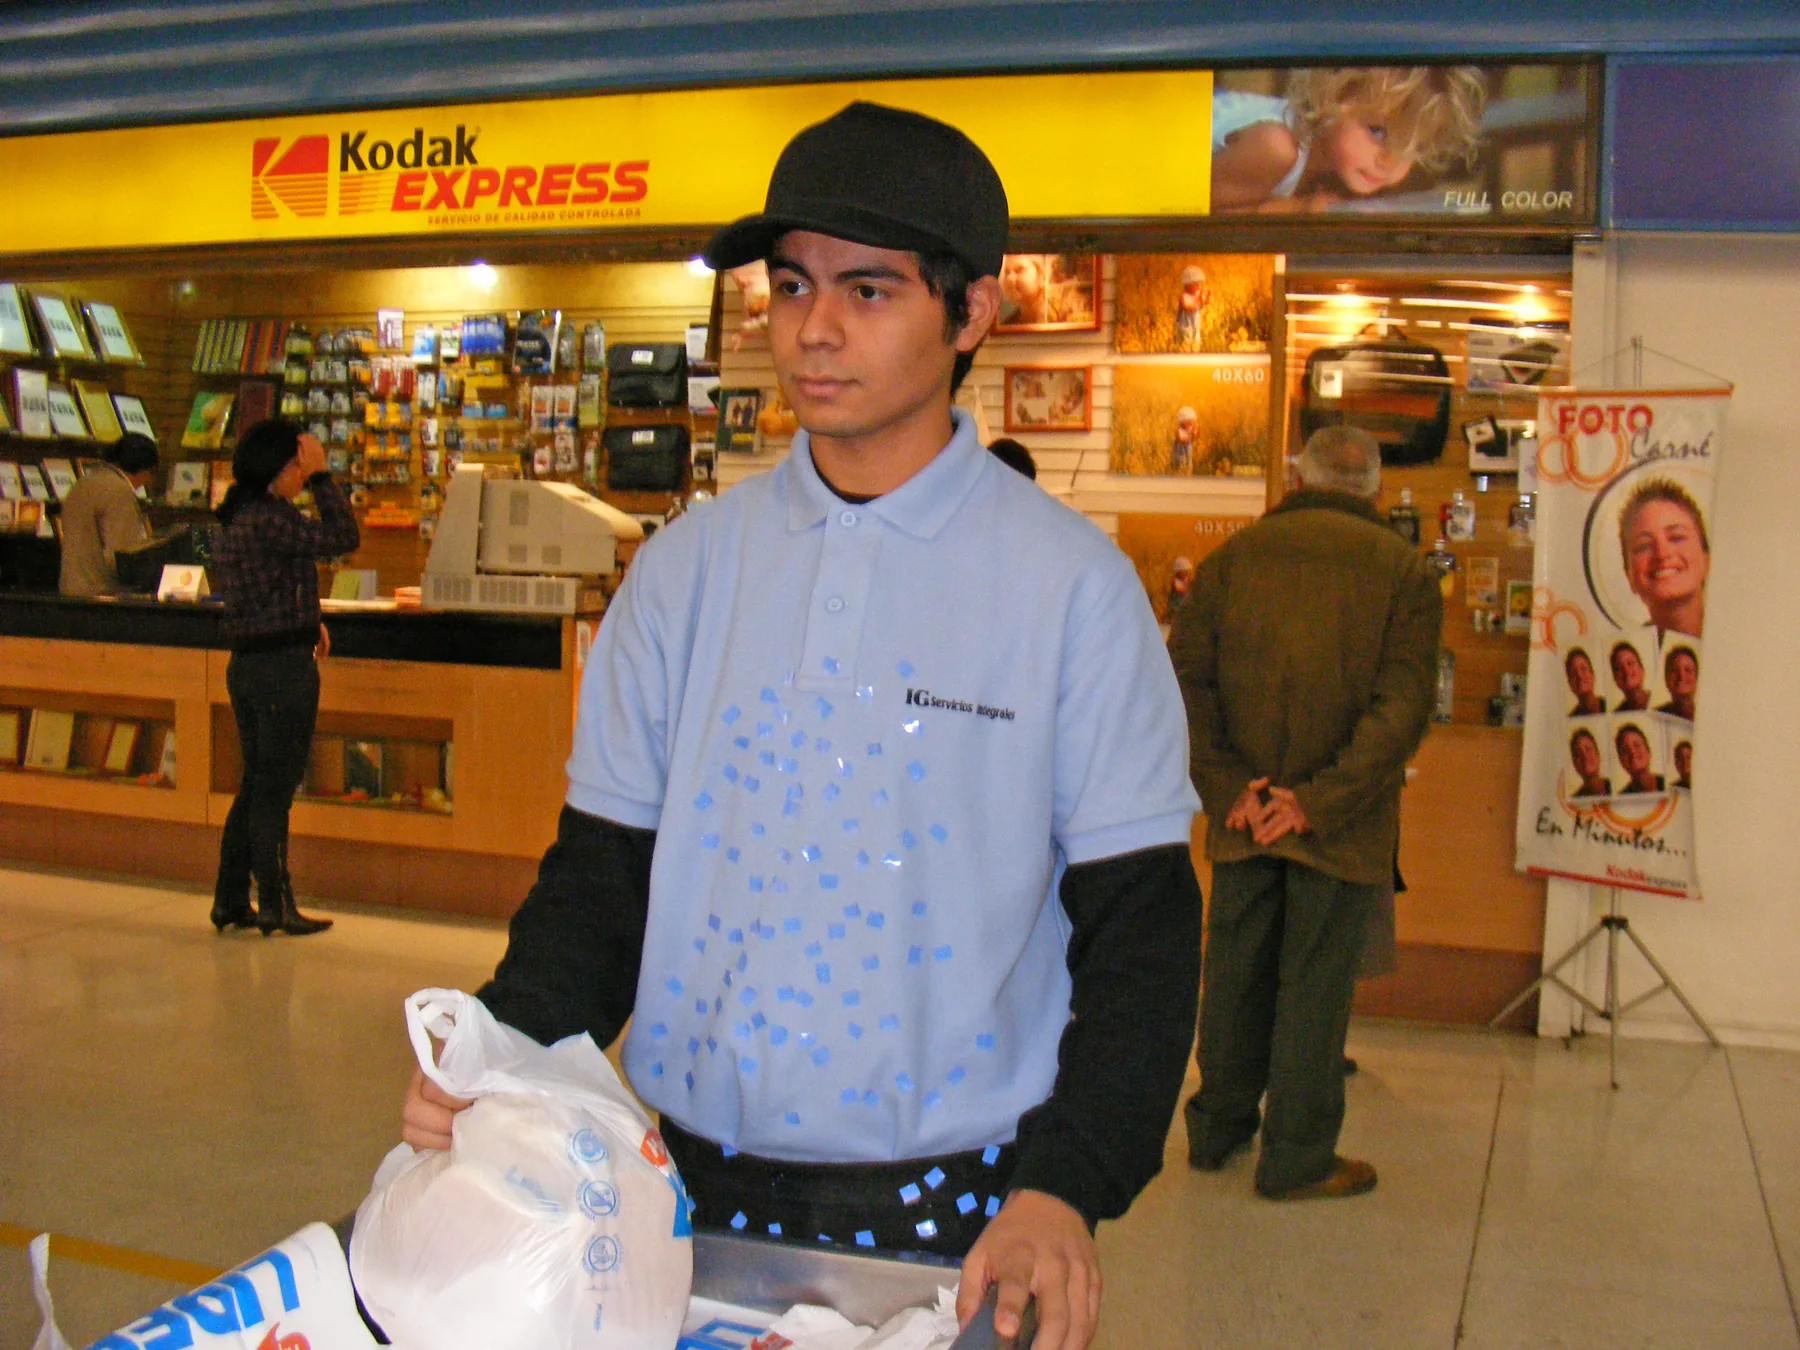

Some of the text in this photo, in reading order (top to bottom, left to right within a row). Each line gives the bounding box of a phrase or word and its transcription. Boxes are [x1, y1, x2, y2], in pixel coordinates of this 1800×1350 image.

[339, 124, 478, 172] Kodak
[390, 160, 650, 212] EXPRESS
[1443, 190, 1573, 210] FULL COLOR
[427, 207, 642, 225] SERVICIO DE CALIDAD CONTROLADA
[1558, 404, 1654, 435] FOTO
[1631, 416, 1715, 461] Carné
[905, 687, 930, 707] IG
[1534, 806, 1563, 837] En
